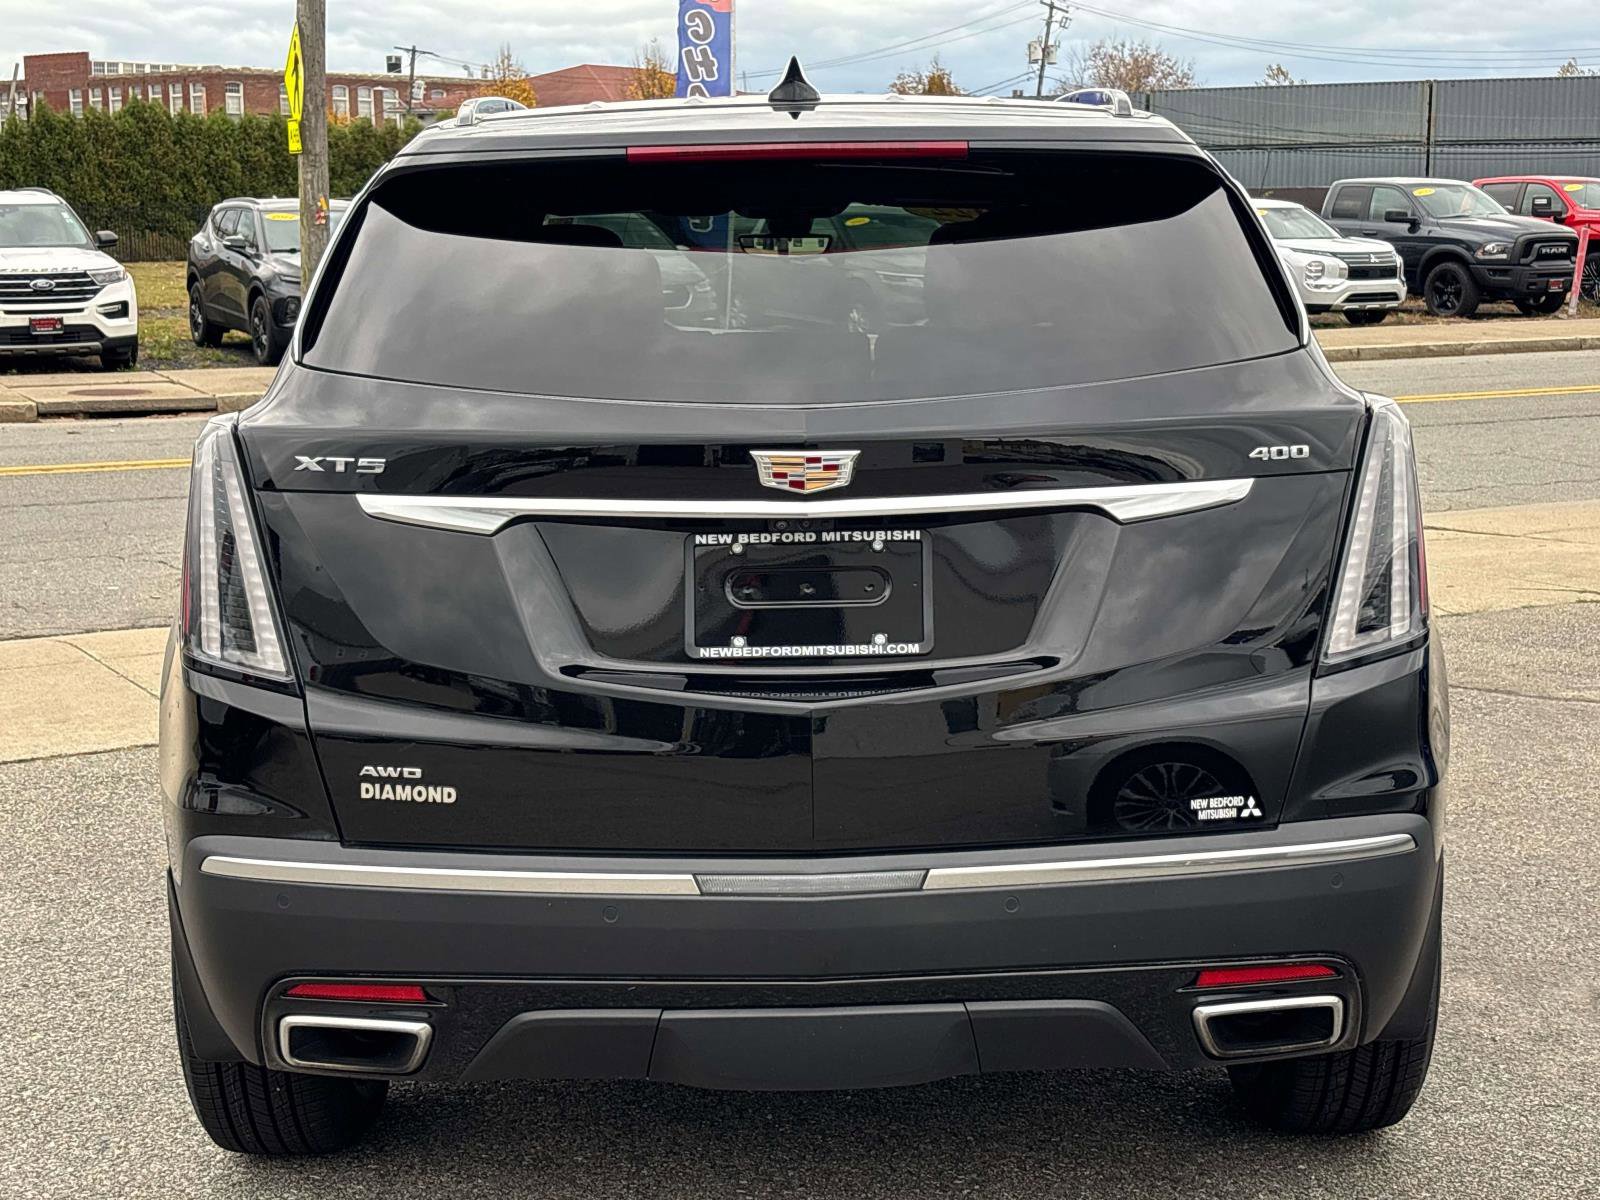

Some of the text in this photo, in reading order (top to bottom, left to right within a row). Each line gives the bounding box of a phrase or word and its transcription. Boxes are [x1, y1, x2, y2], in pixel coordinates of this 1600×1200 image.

[1541, 246, 1568, 254] RAM
[1248, 444, 1310, 461] 400
[293, 455, 387, 474] XT5
[695, 530, 921, 545] NEW BEDFORD MITSUBISHI
[699, 643, 920, 658] NEWBEDFORDMITSUBISHI.COM
[359, 765, 422, 779] AWD
[360, 782, 457, 804] DIAMOND
[1190, 796, 1245, 810] NEW BEDFORD
[1198, 808, 1237, 820] MITSUBISHI
